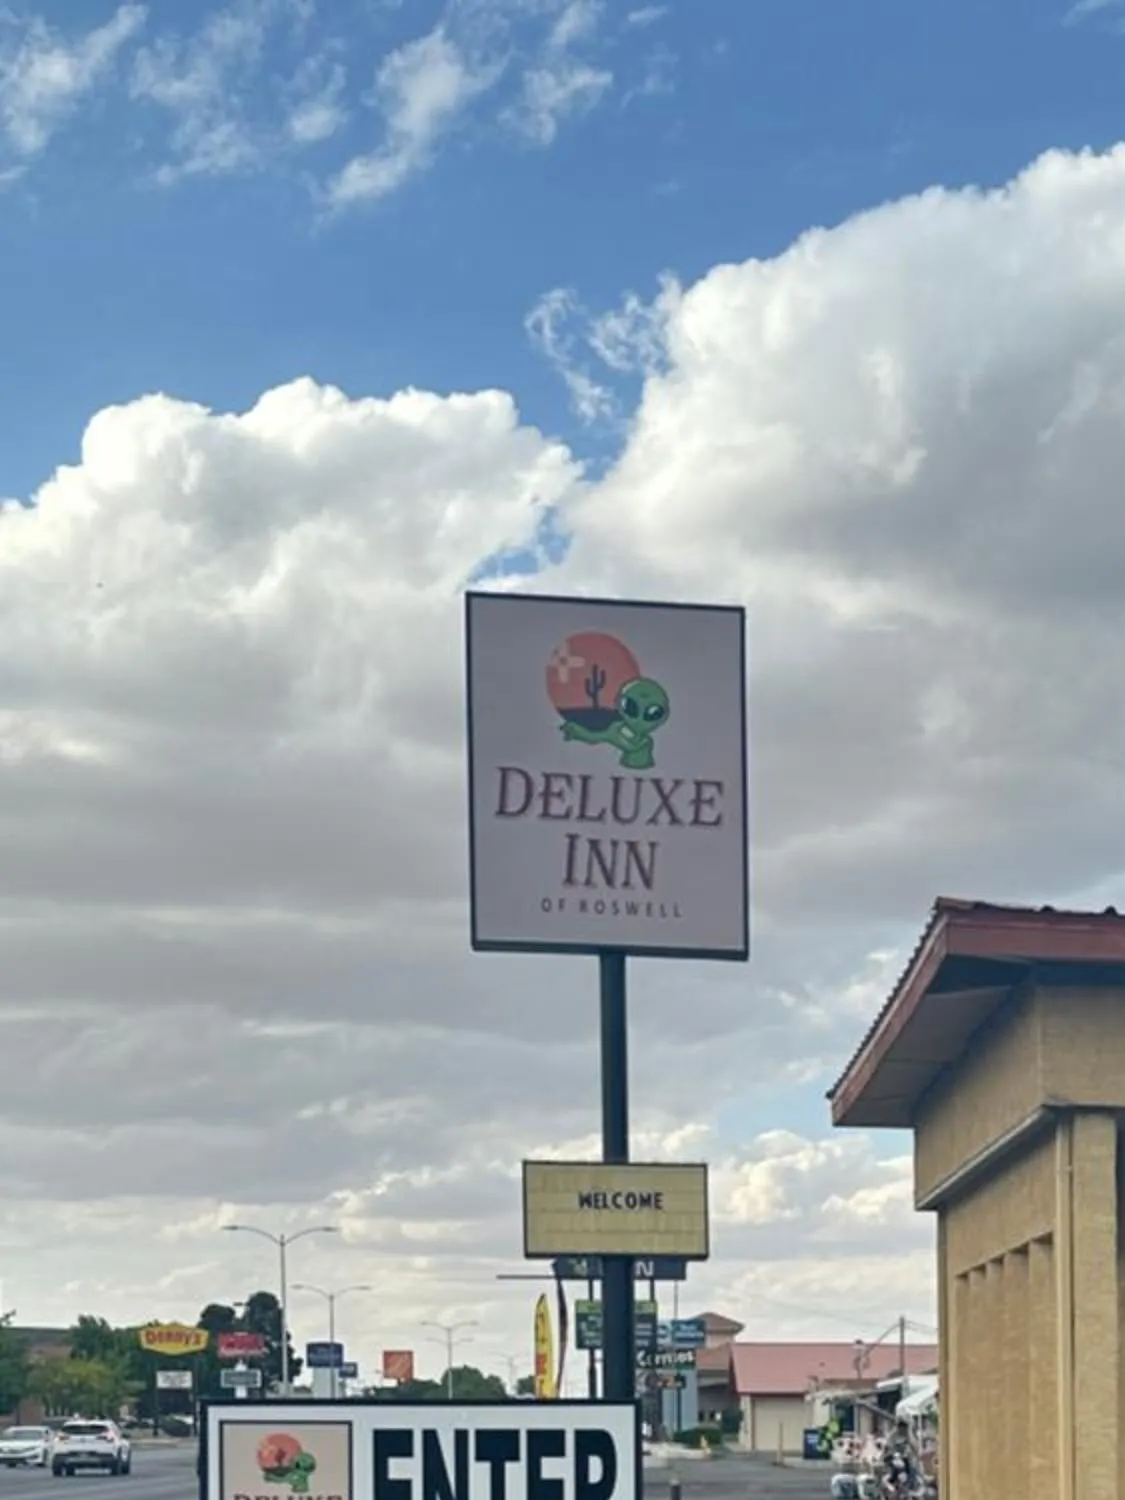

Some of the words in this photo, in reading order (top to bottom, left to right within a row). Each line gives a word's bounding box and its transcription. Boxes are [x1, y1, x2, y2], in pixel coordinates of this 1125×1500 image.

[494, 765, 724, 828] DELUXE
[561, 832, 660, 891] INN
[541, 897, 566, 912] OF
[579, 899, 682, 918] ROSWELL
[578, 1191, 664, 1210] WELCOME
